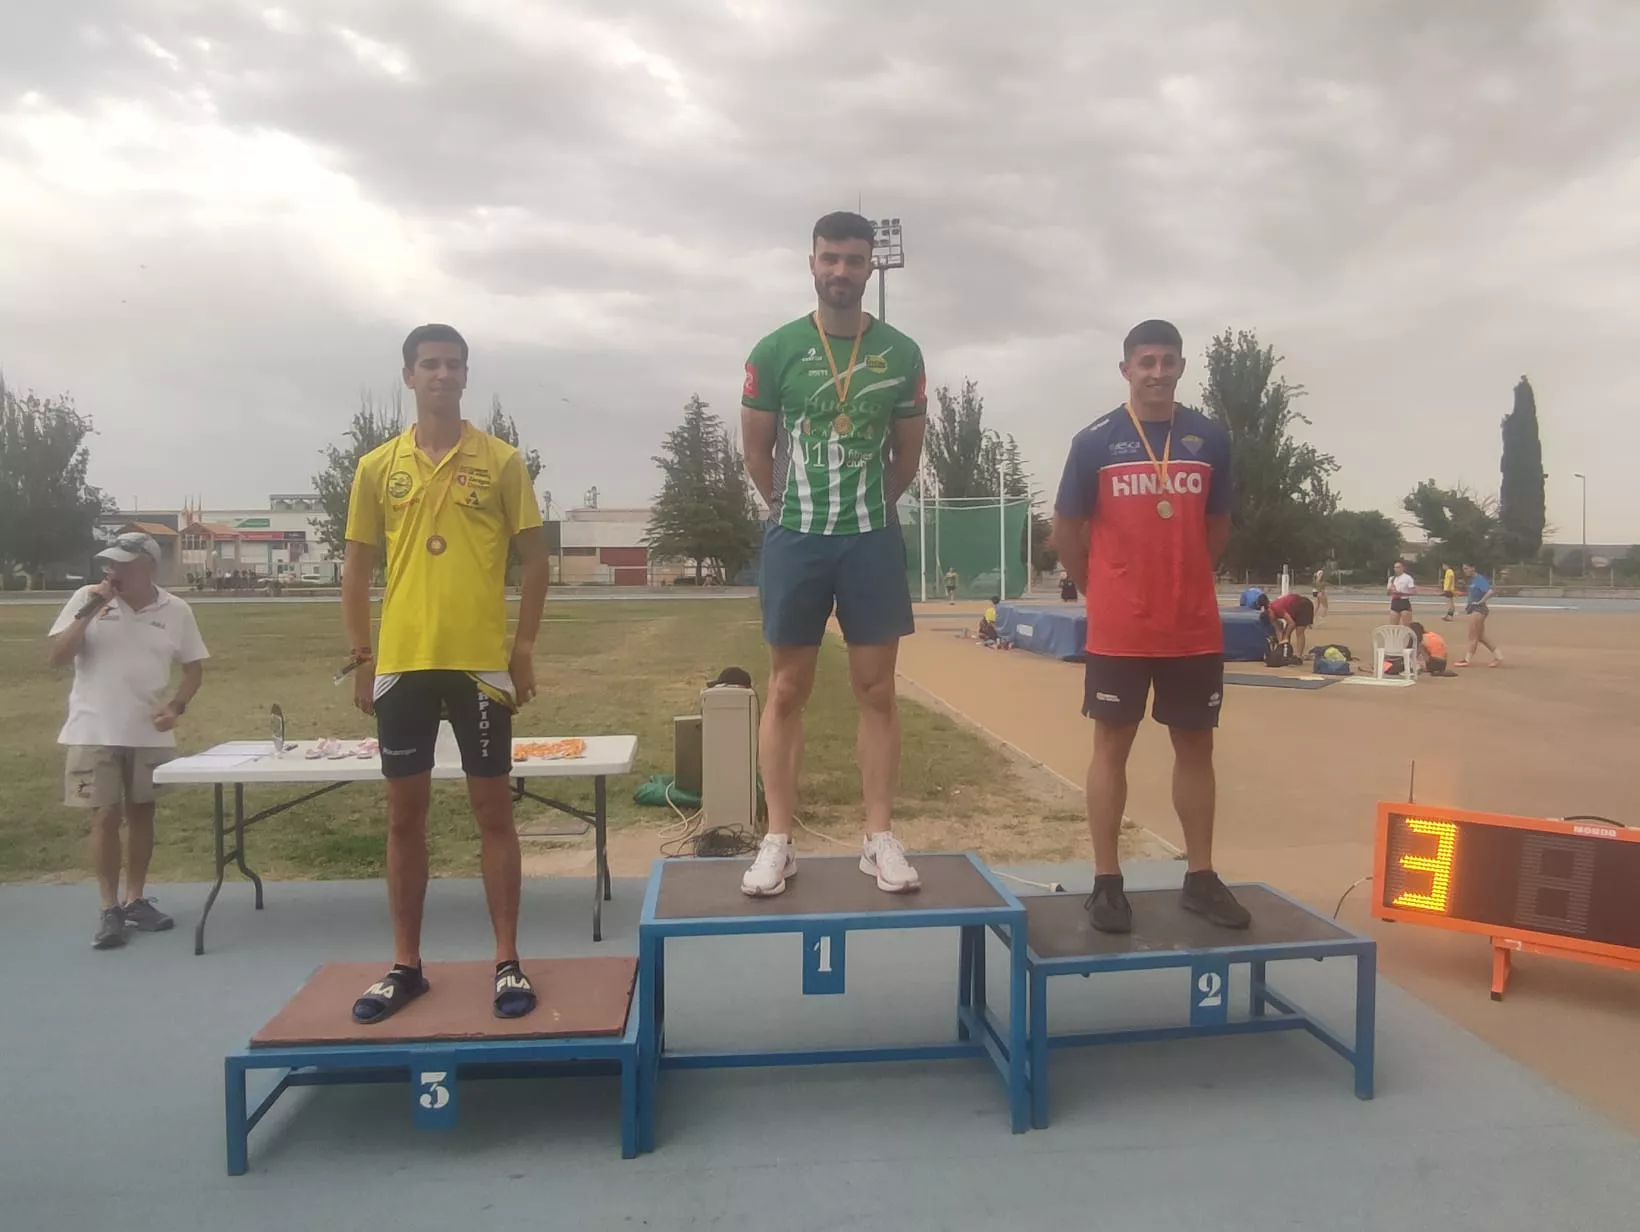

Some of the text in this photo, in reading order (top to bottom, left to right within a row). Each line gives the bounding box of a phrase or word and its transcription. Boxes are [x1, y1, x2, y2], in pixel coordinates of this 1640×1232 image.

[1111, 471, 1202, 497] HINACO
[1392, 818, 1457, 912] 3
[813, 936, 832, 972] 1
[496, 975, 531, 992] FILA
[1198, 972, 1222, 1007] 2
[419, 1071, 450, 1109] 3
